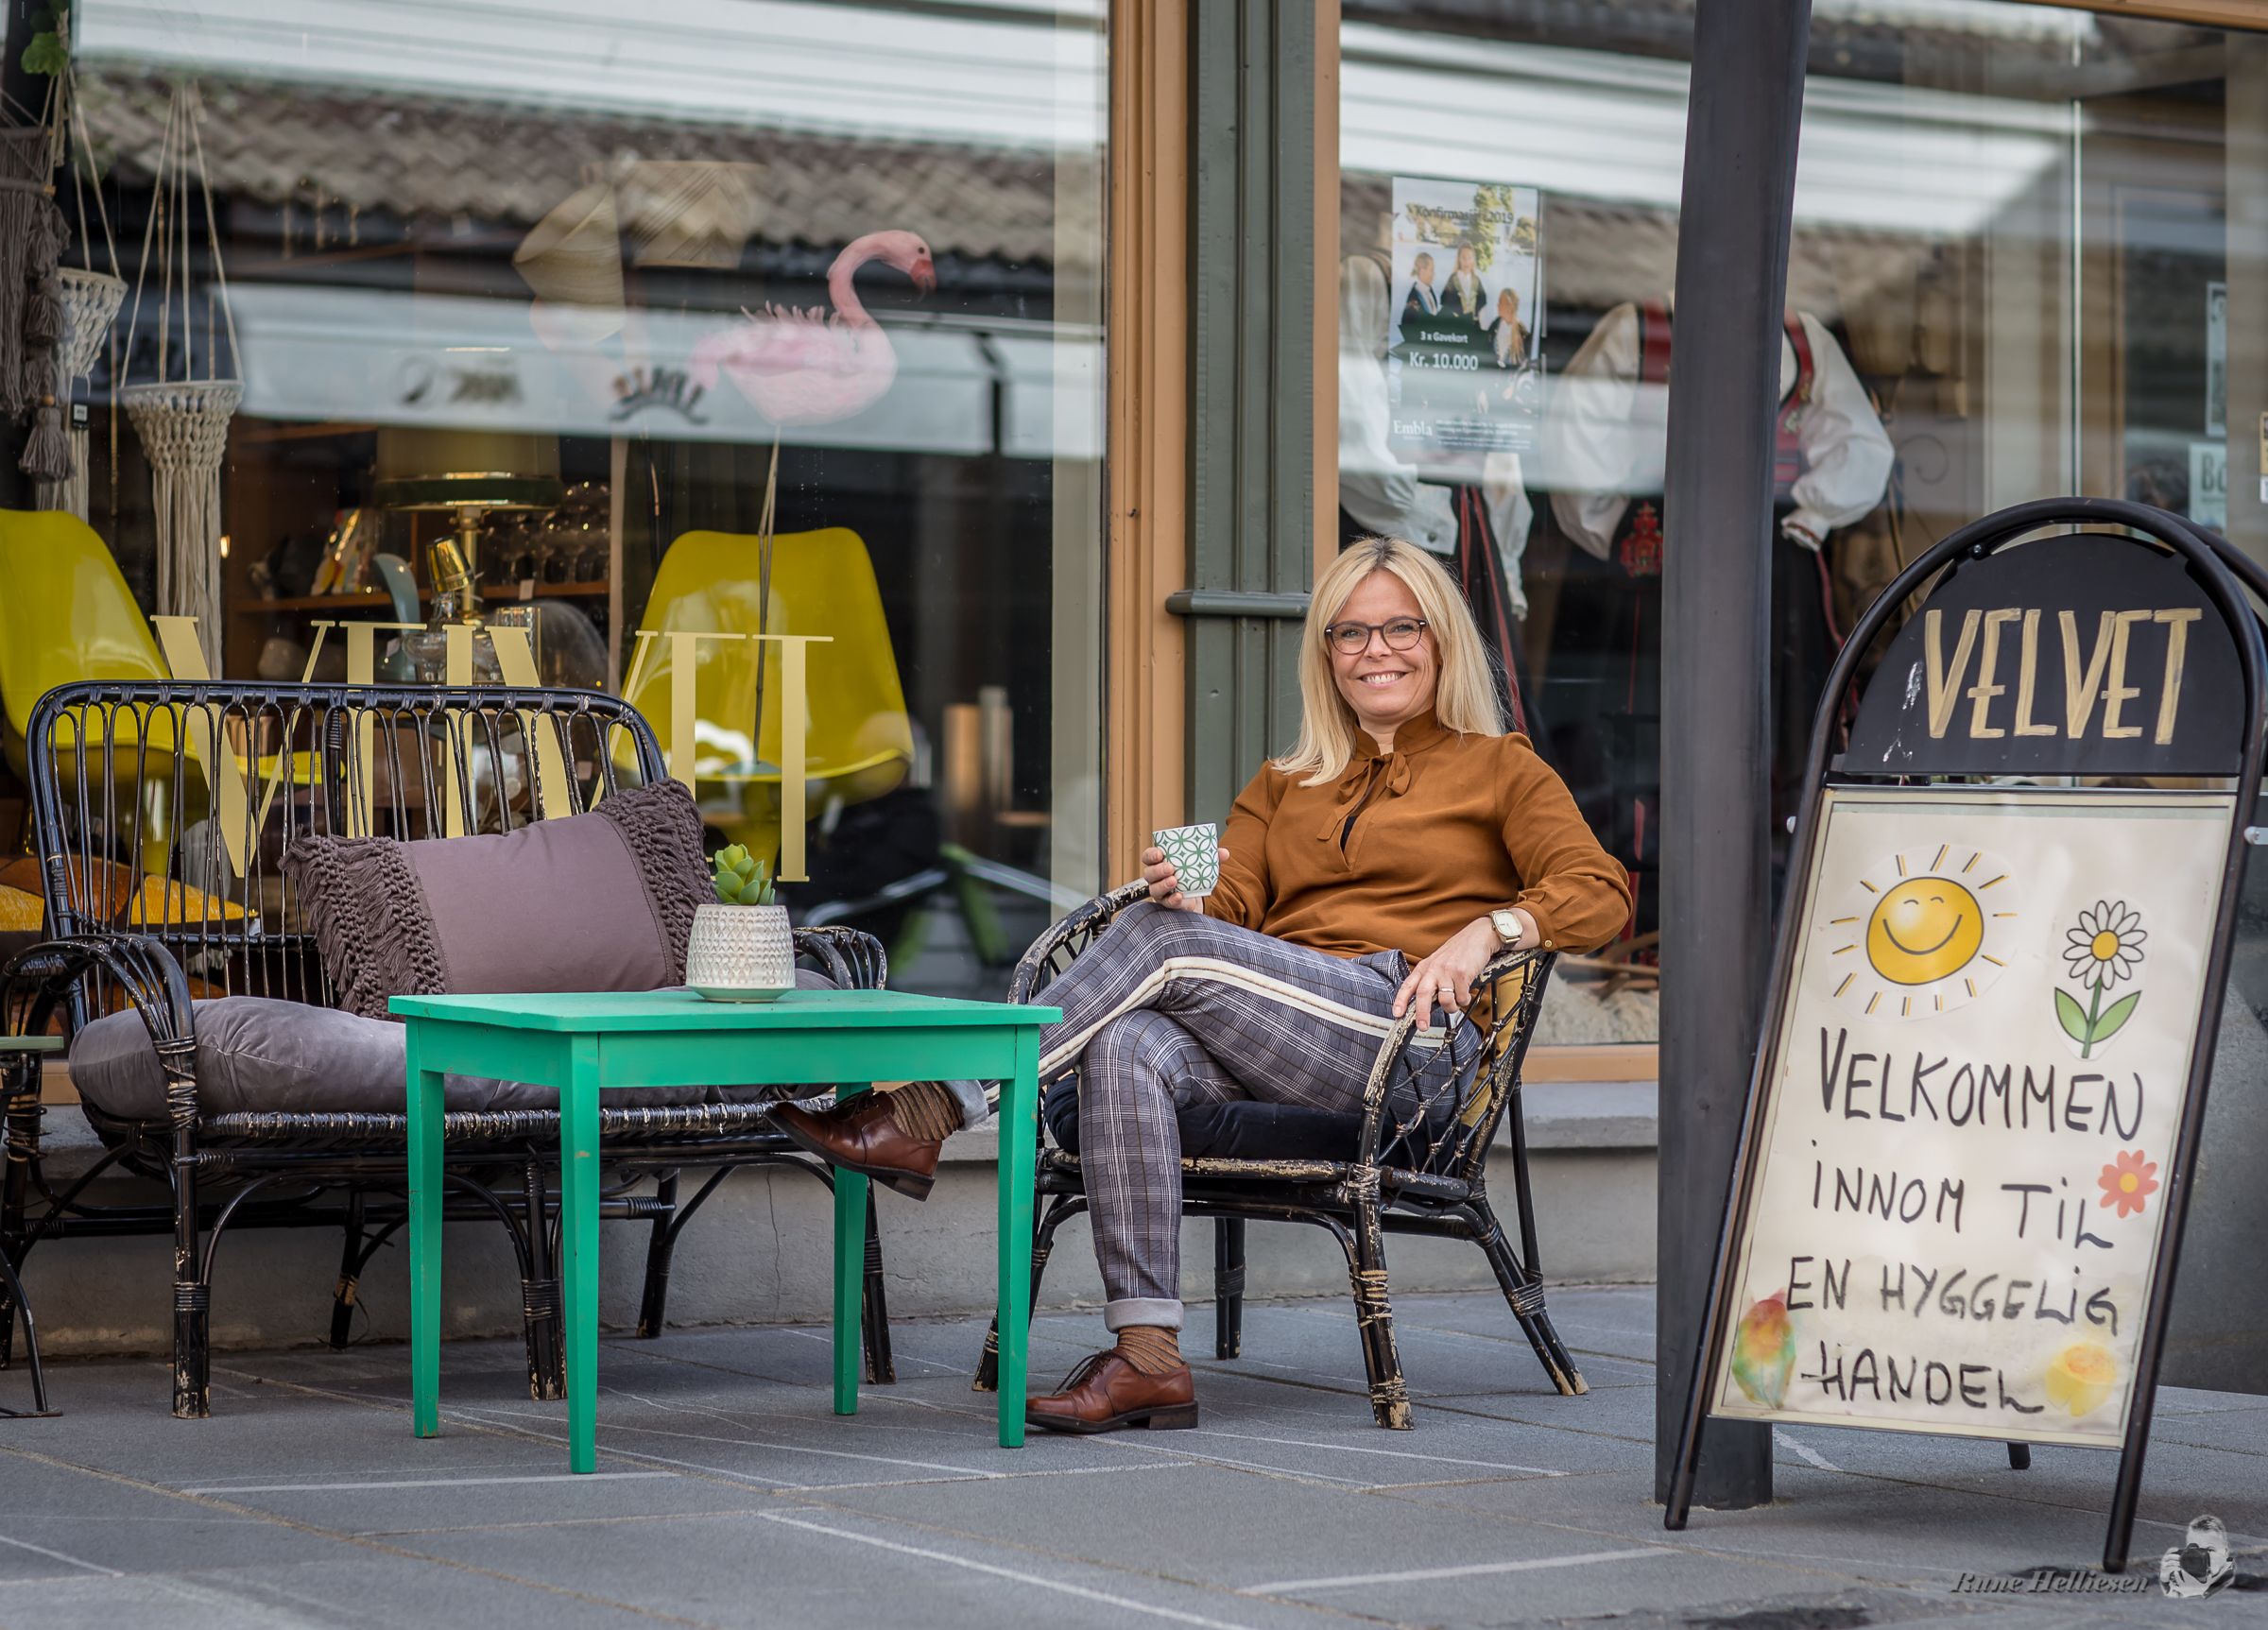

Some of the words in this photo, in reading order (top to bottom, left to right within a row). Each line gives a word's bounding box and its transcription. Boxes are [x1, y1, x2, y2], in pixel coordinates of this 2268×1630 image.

[1409, 351, 1429, 368] Kr.
[1433, 352, 1479, 370] 10.000
[1420, 331, 1426, 341] 3
[1433, 331, 1469, 344] Gavekort
[1393, 420, 1434, 437] Embla
[1925, 608, 2202, 745] VELVET
[1820, 1026, 2144, 1141] VELKOMMEN
[1786, 1256, 1851, 1312] EN
[1800, 1340, 2045, 1414] HANDEL
